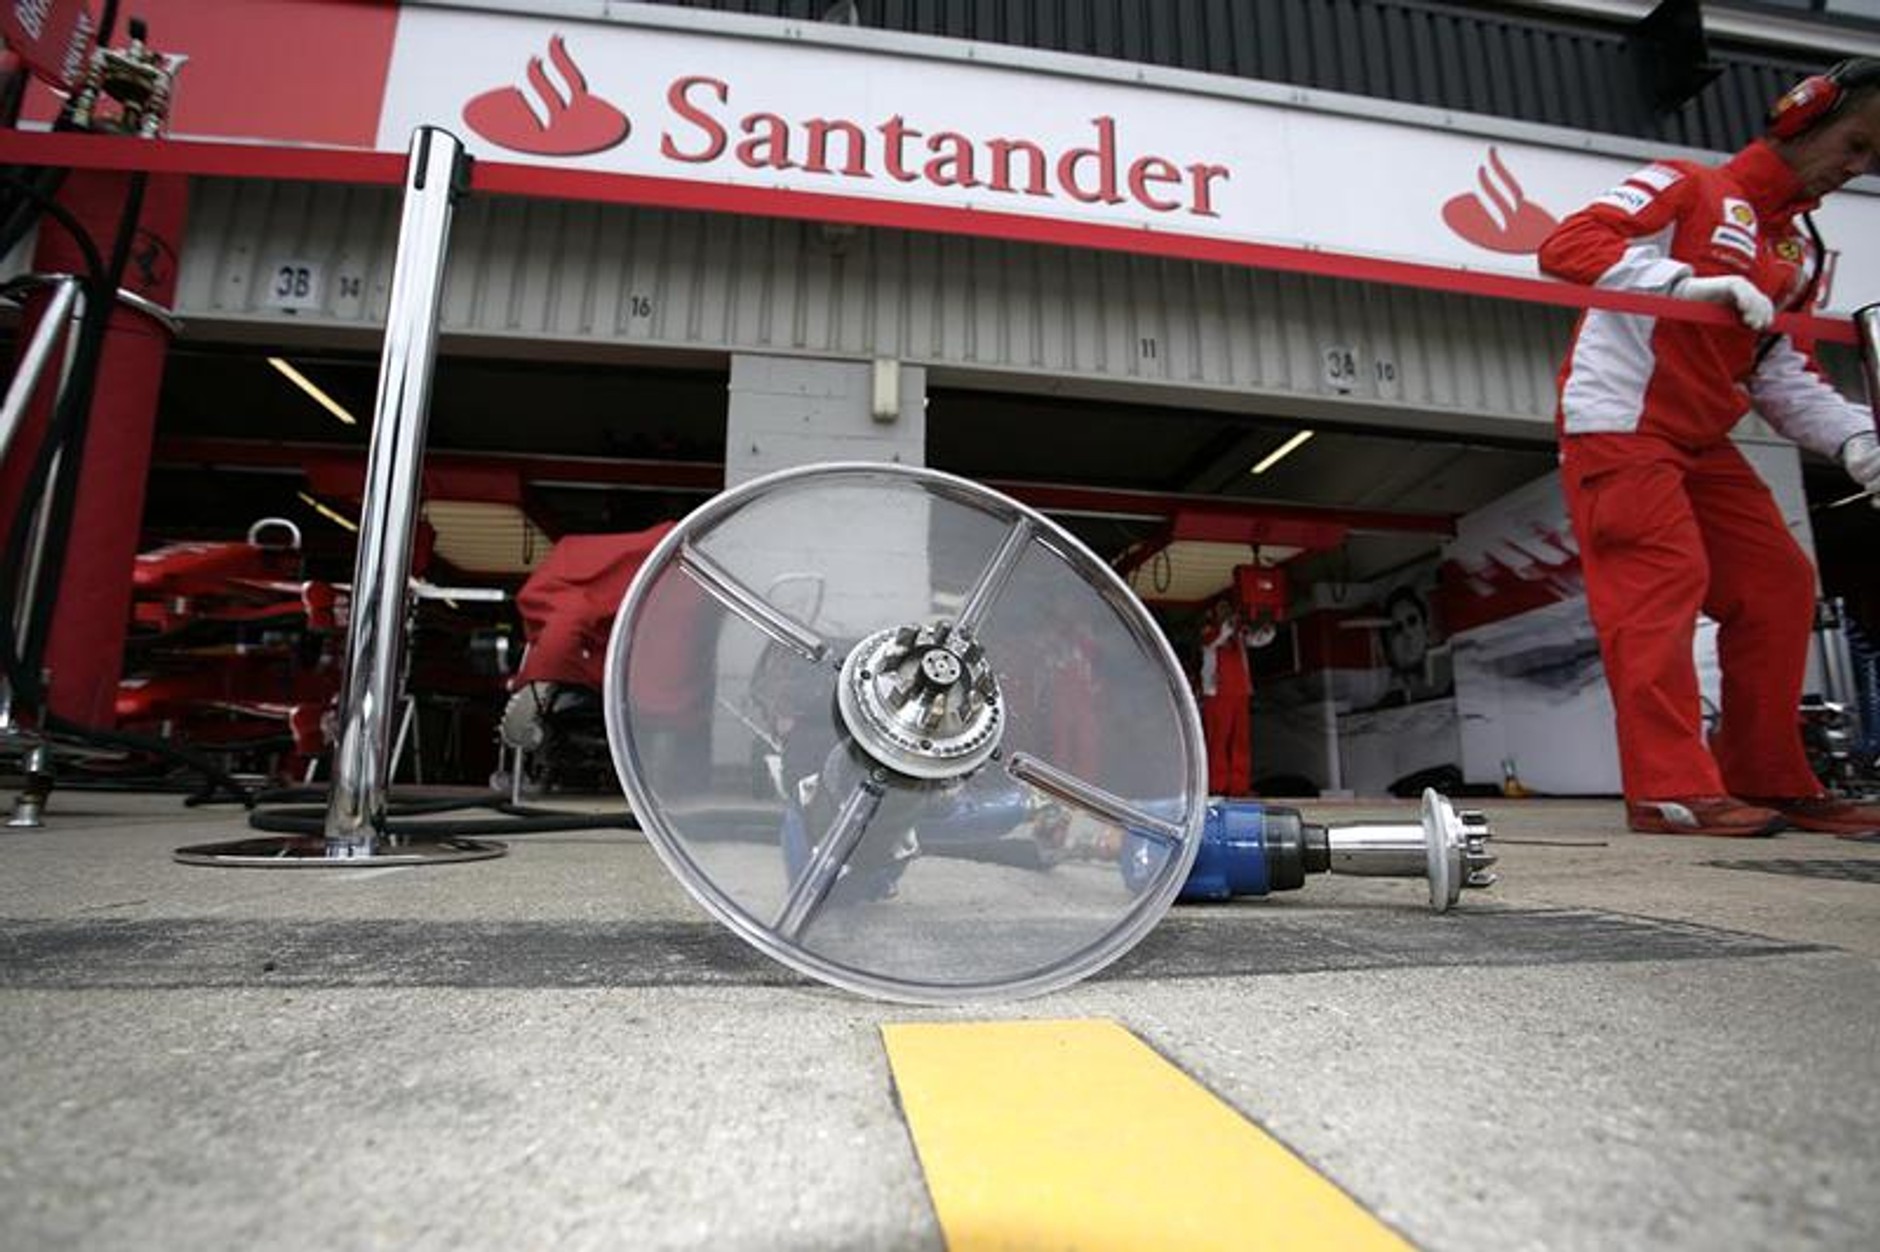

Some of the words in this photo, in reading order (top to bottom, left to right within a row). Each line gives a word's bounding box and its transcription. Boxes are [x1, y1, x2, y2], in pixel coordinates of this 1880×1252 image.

[660, 75, 1230, 217] Santander
[277, 265, 311, 298] 3B
[632, 295, 651, 318] 16
[1140, 337, 1156, 359] 11
